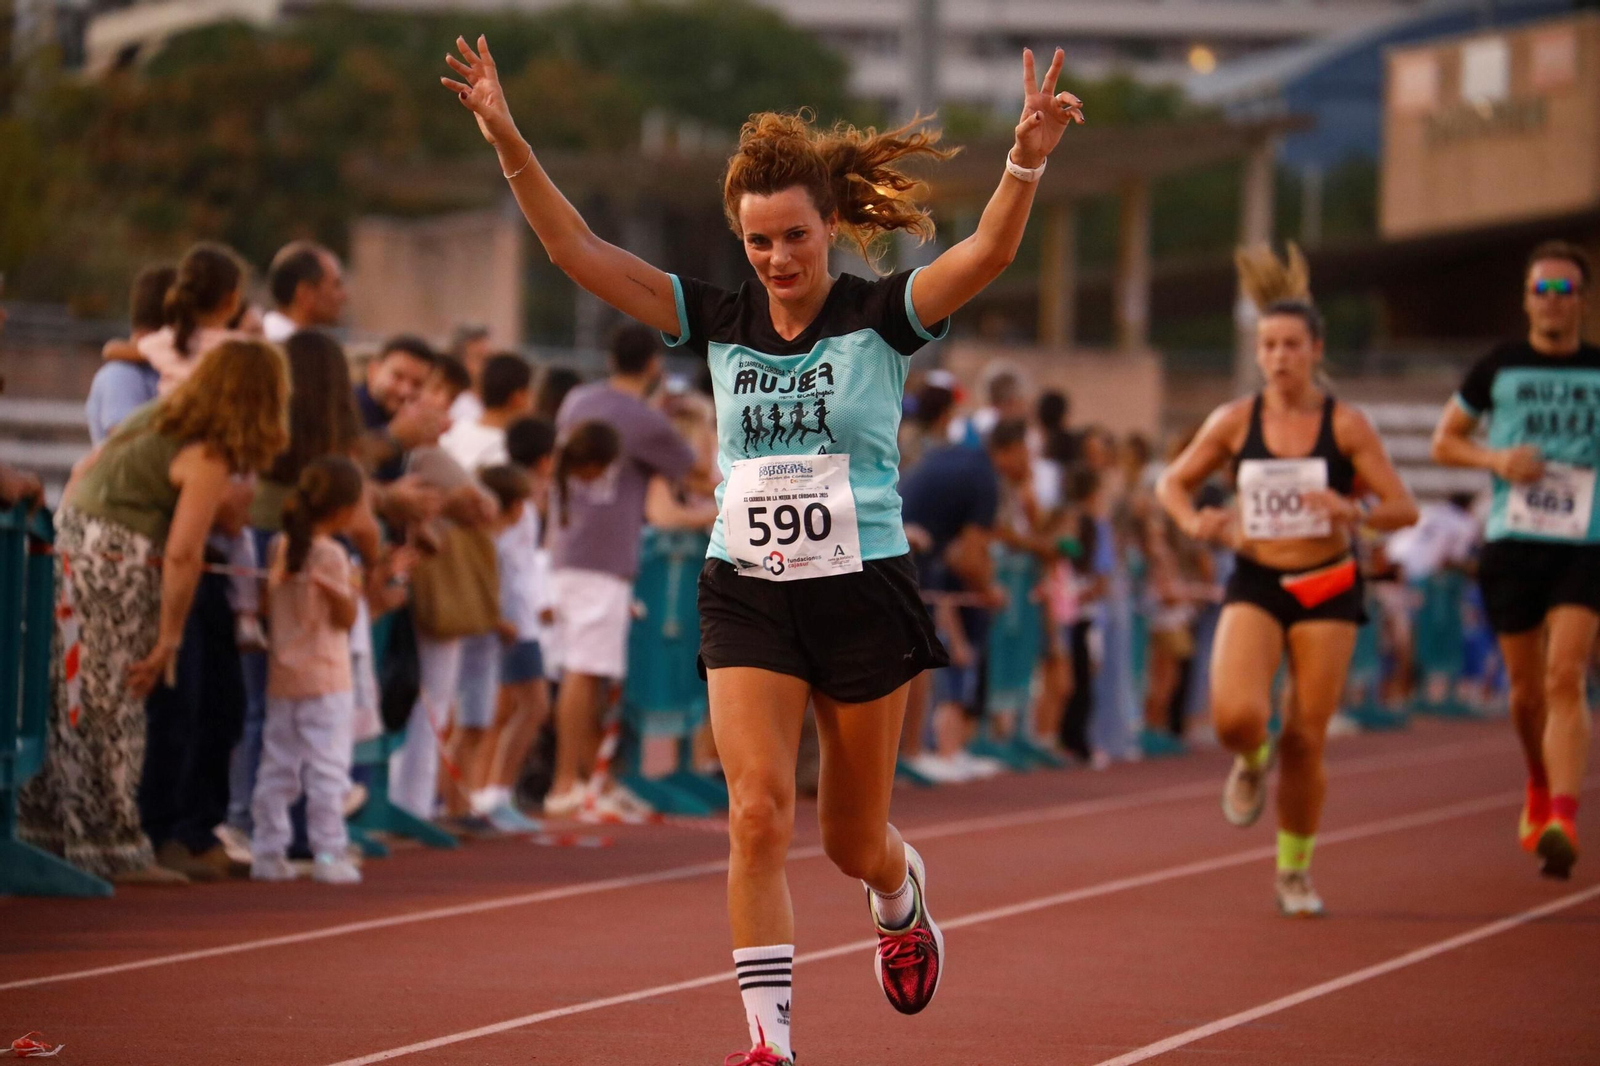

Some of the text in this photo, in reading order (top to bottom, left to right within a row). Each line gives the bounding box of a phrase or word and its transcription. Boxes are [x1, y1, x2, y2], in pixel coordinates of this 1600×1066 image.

[733, 362, 834, 395] MUJER
[759, 463, 804, 471] carreras
[759, 467, 813, 477] populares
[748, 502, 832, 547] 590
[787, 555, 822, 563] fundaciones
